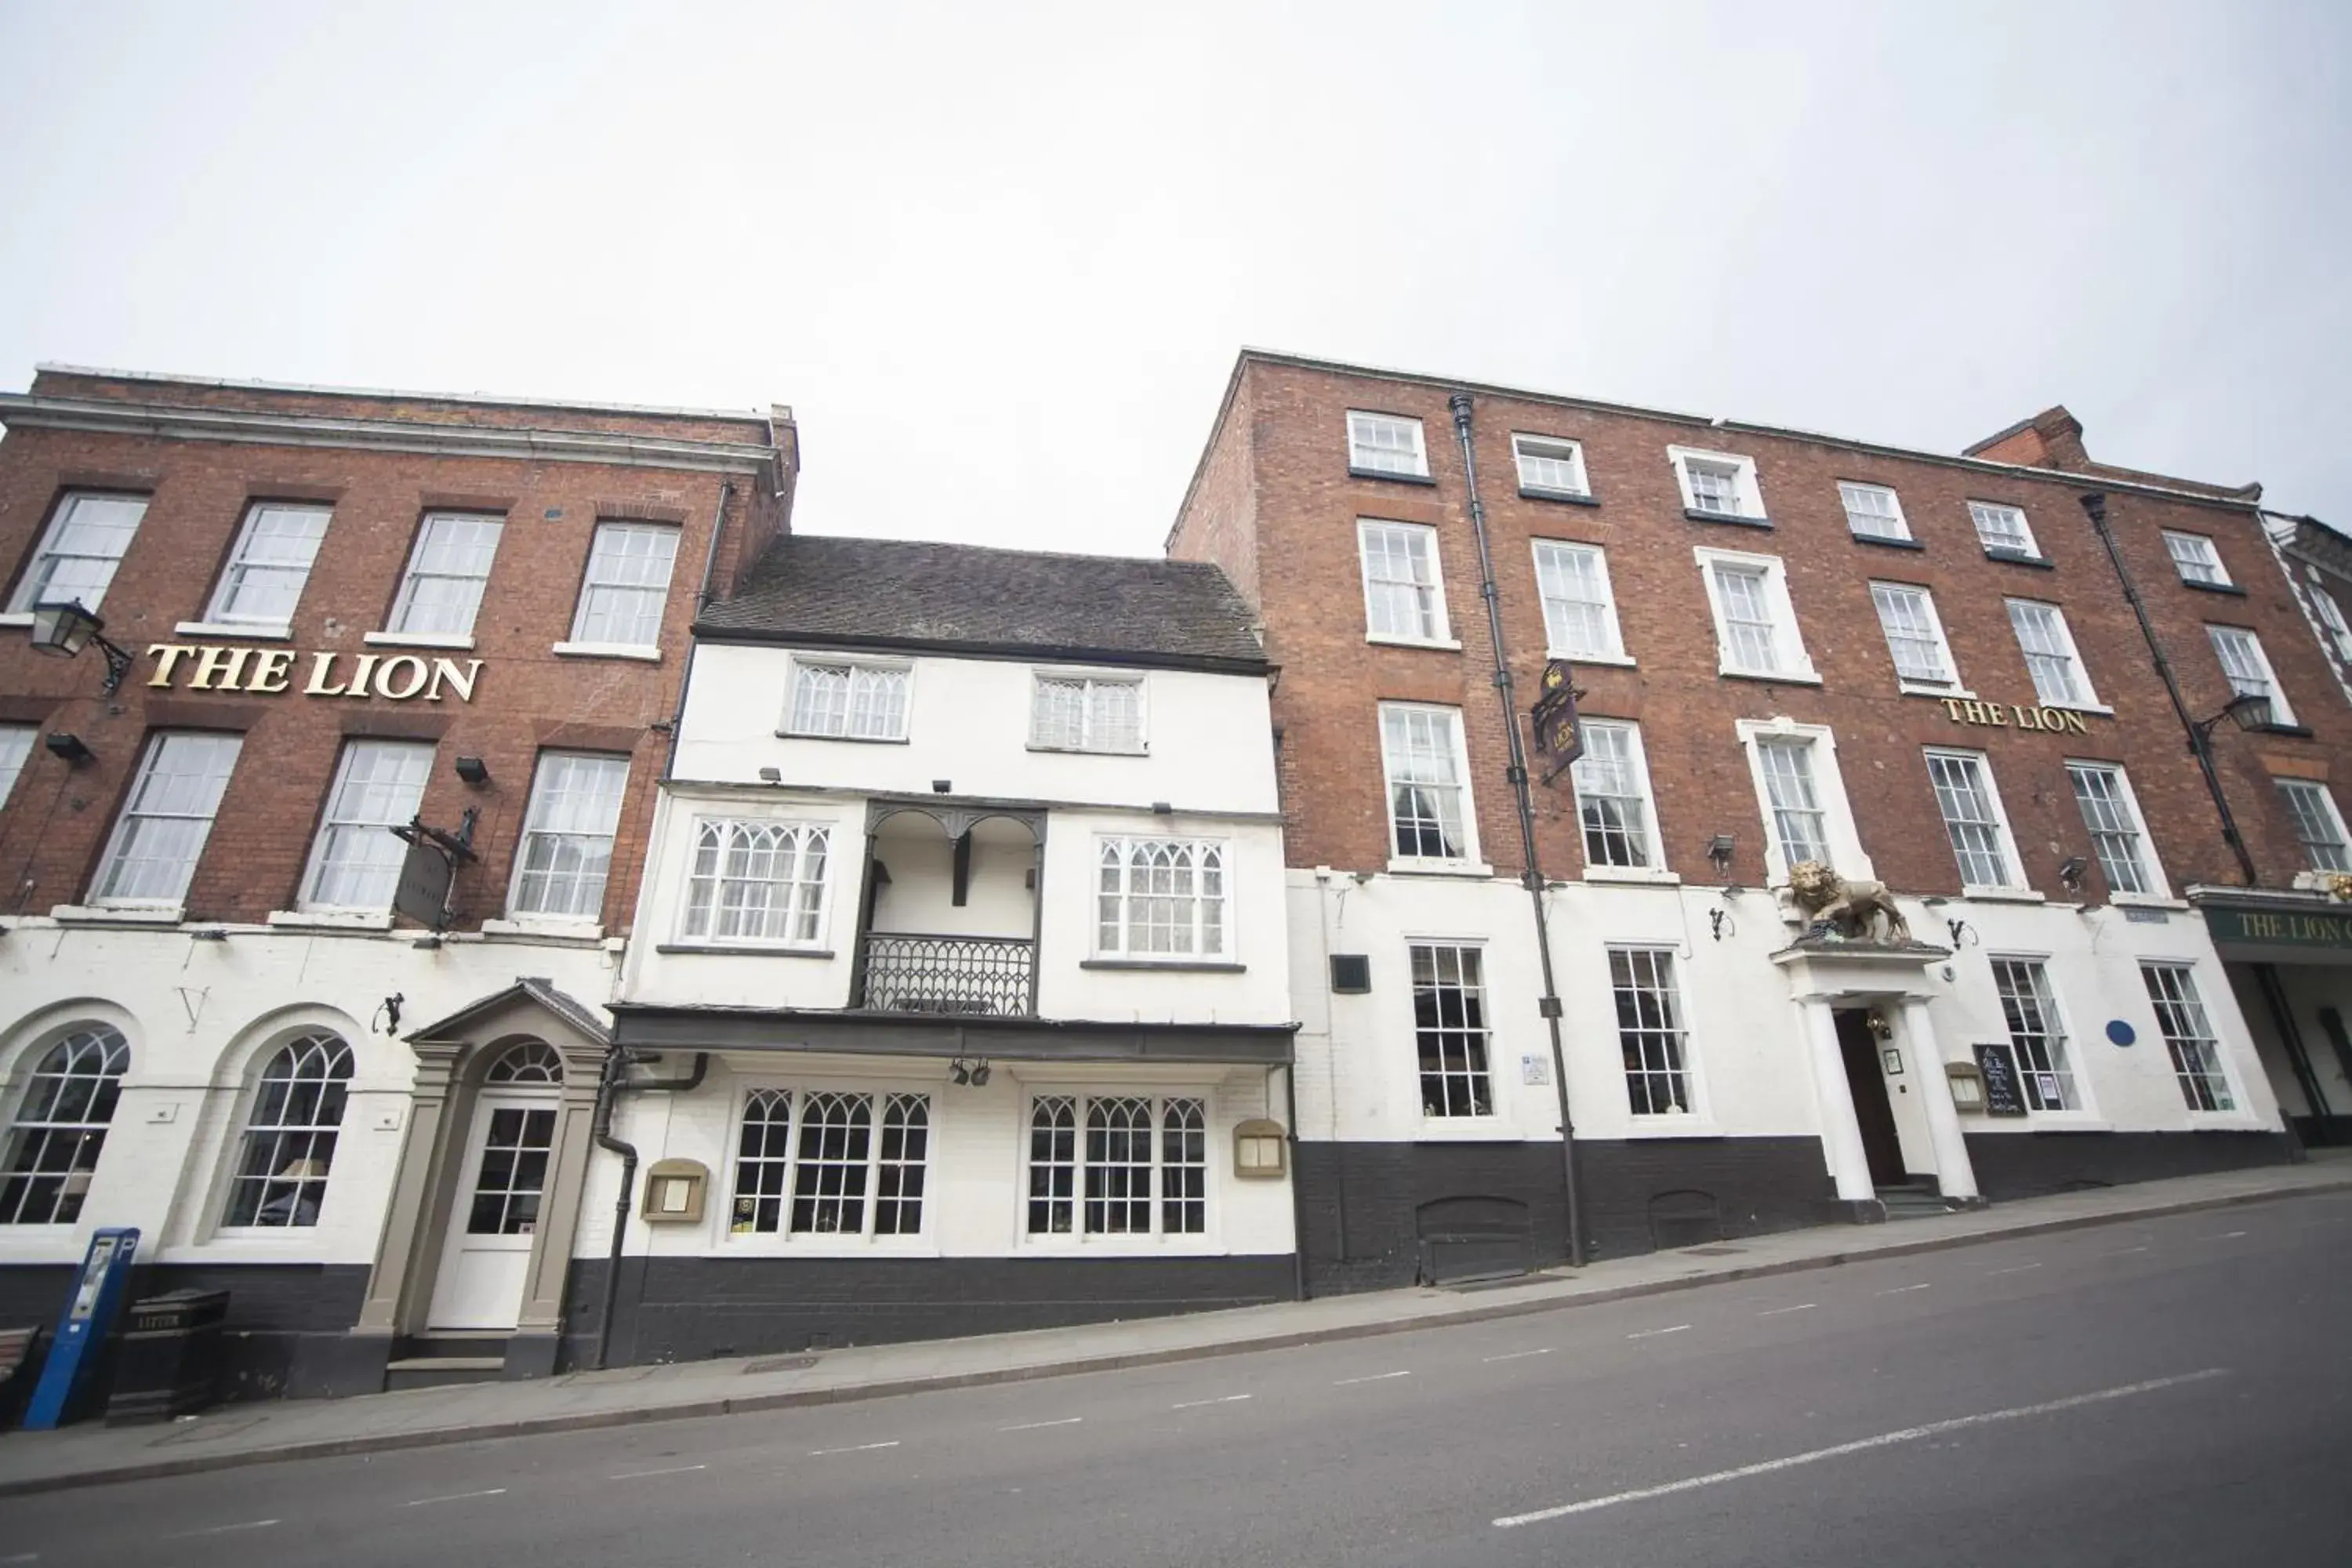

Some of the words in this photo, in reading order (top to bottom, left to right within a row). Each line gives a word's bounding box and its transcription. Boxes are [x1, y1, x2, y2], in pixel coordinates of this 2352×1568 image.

[147, 644, 296, 692] THE
[302, 652, 485, 702] LION
[1940, 698, 2008, 726] THE
[2012, 705, 2089, 735] LION
[2236, 913, 2287, 937] THE
[2289, 916, 2341, 941] LION
[118, 1236, 136, 1260] P
